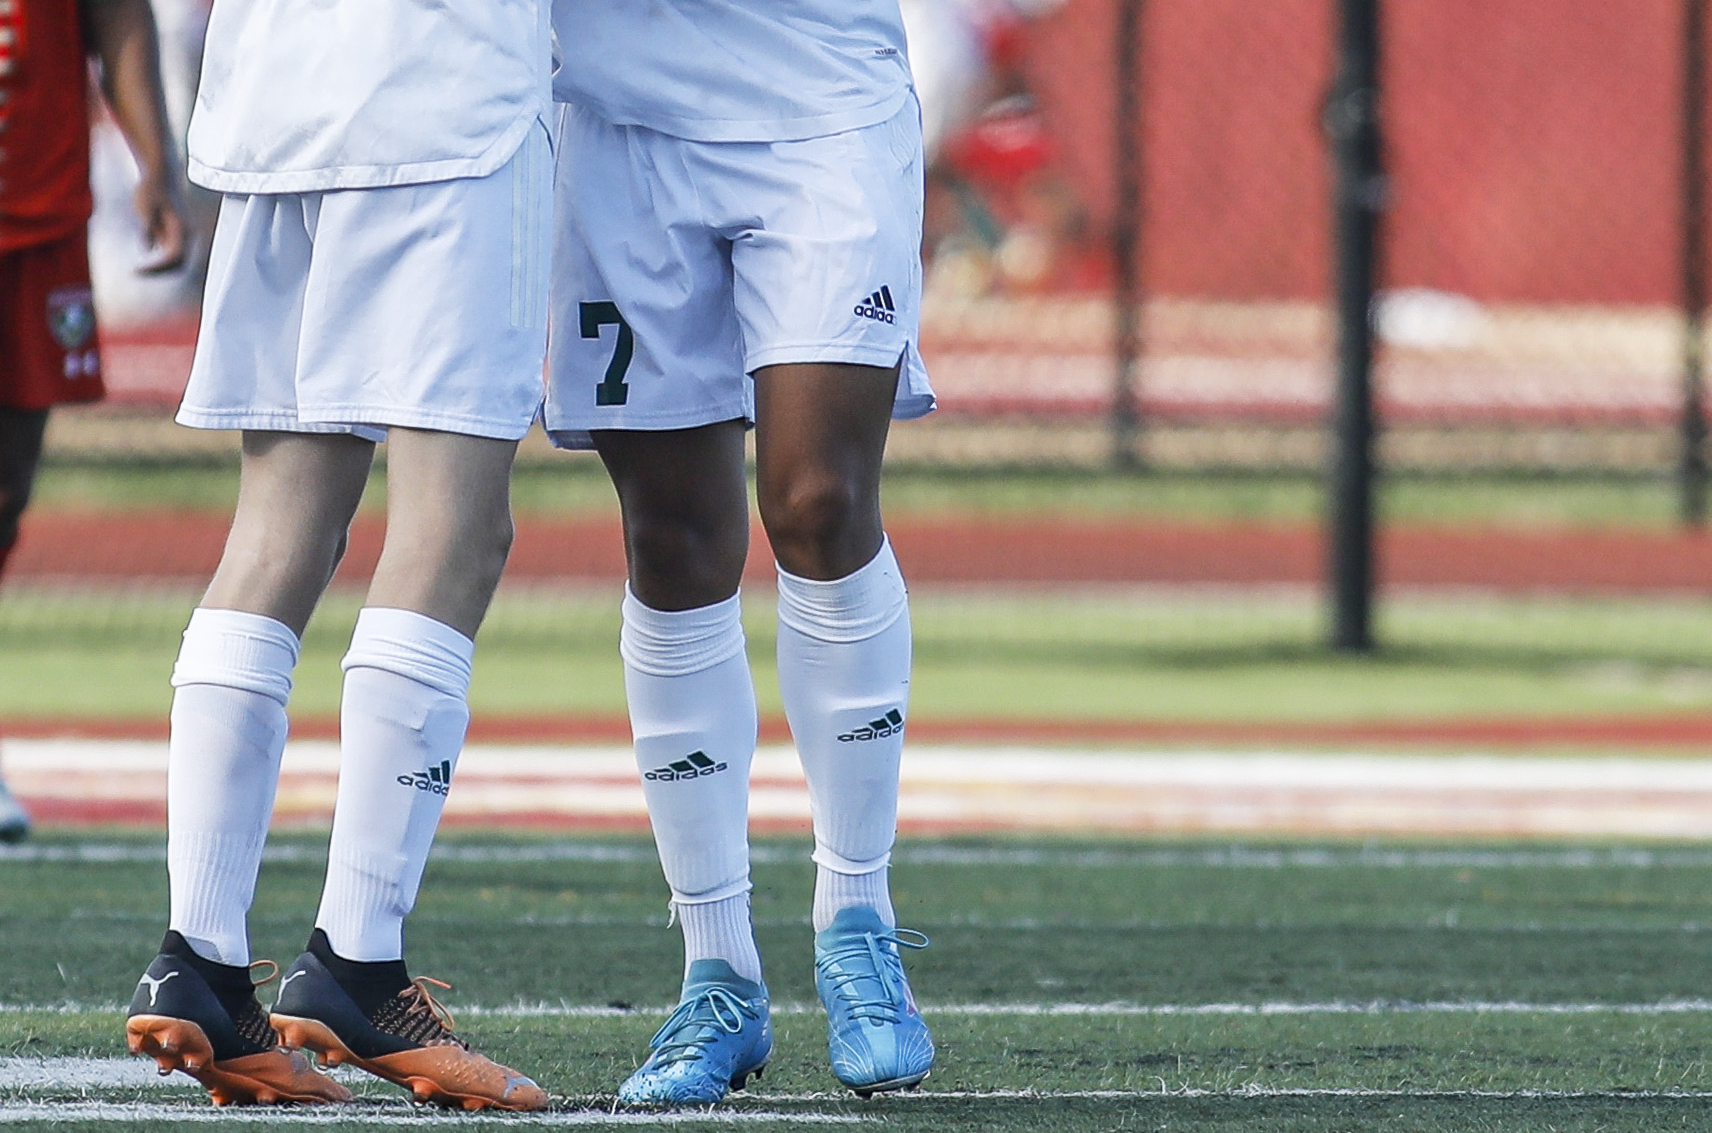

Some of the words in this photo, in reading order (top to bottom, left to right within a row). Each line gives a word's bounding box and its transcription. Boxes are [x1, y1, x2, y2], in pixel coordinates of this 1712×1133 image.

[578, 301, 635, 407] 7
[836, 721, 905, 743] adida
[644, 761, 728, 782] adidas
[396, 774, 450, 797] adida
